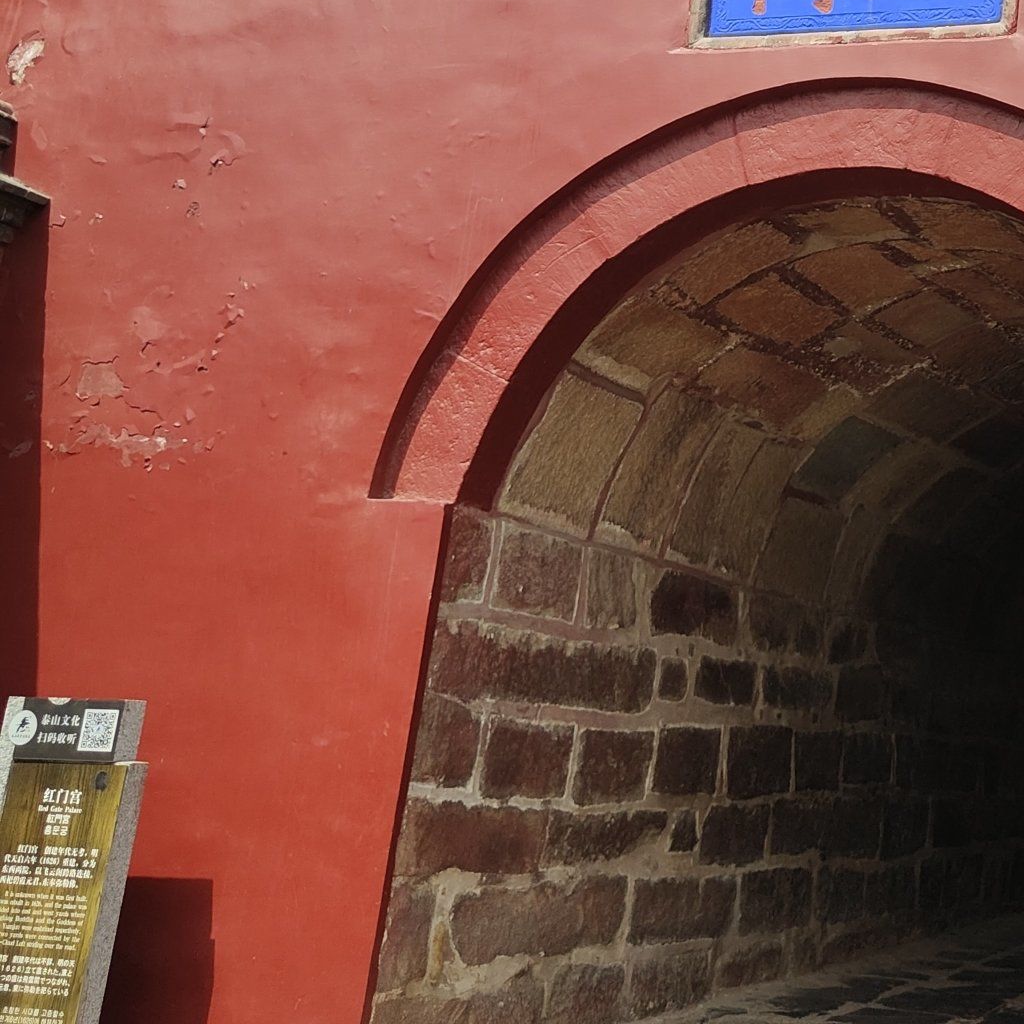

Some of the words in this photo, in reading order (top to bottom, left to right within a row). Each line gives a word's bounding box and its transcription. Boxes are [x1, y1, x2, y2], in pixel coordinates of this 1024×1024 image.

[41, 713, 80, 727] 泰山文化
[37, 731, 77, 744] 扫码收听
[42, 787, 82, 805] 红门宫
[38, 804, 49, 812] Red
[50, 805, 63, 813] Gate
[64, 806, 82, 814] Palace
[17, 844, 39, 854] 红门宫
